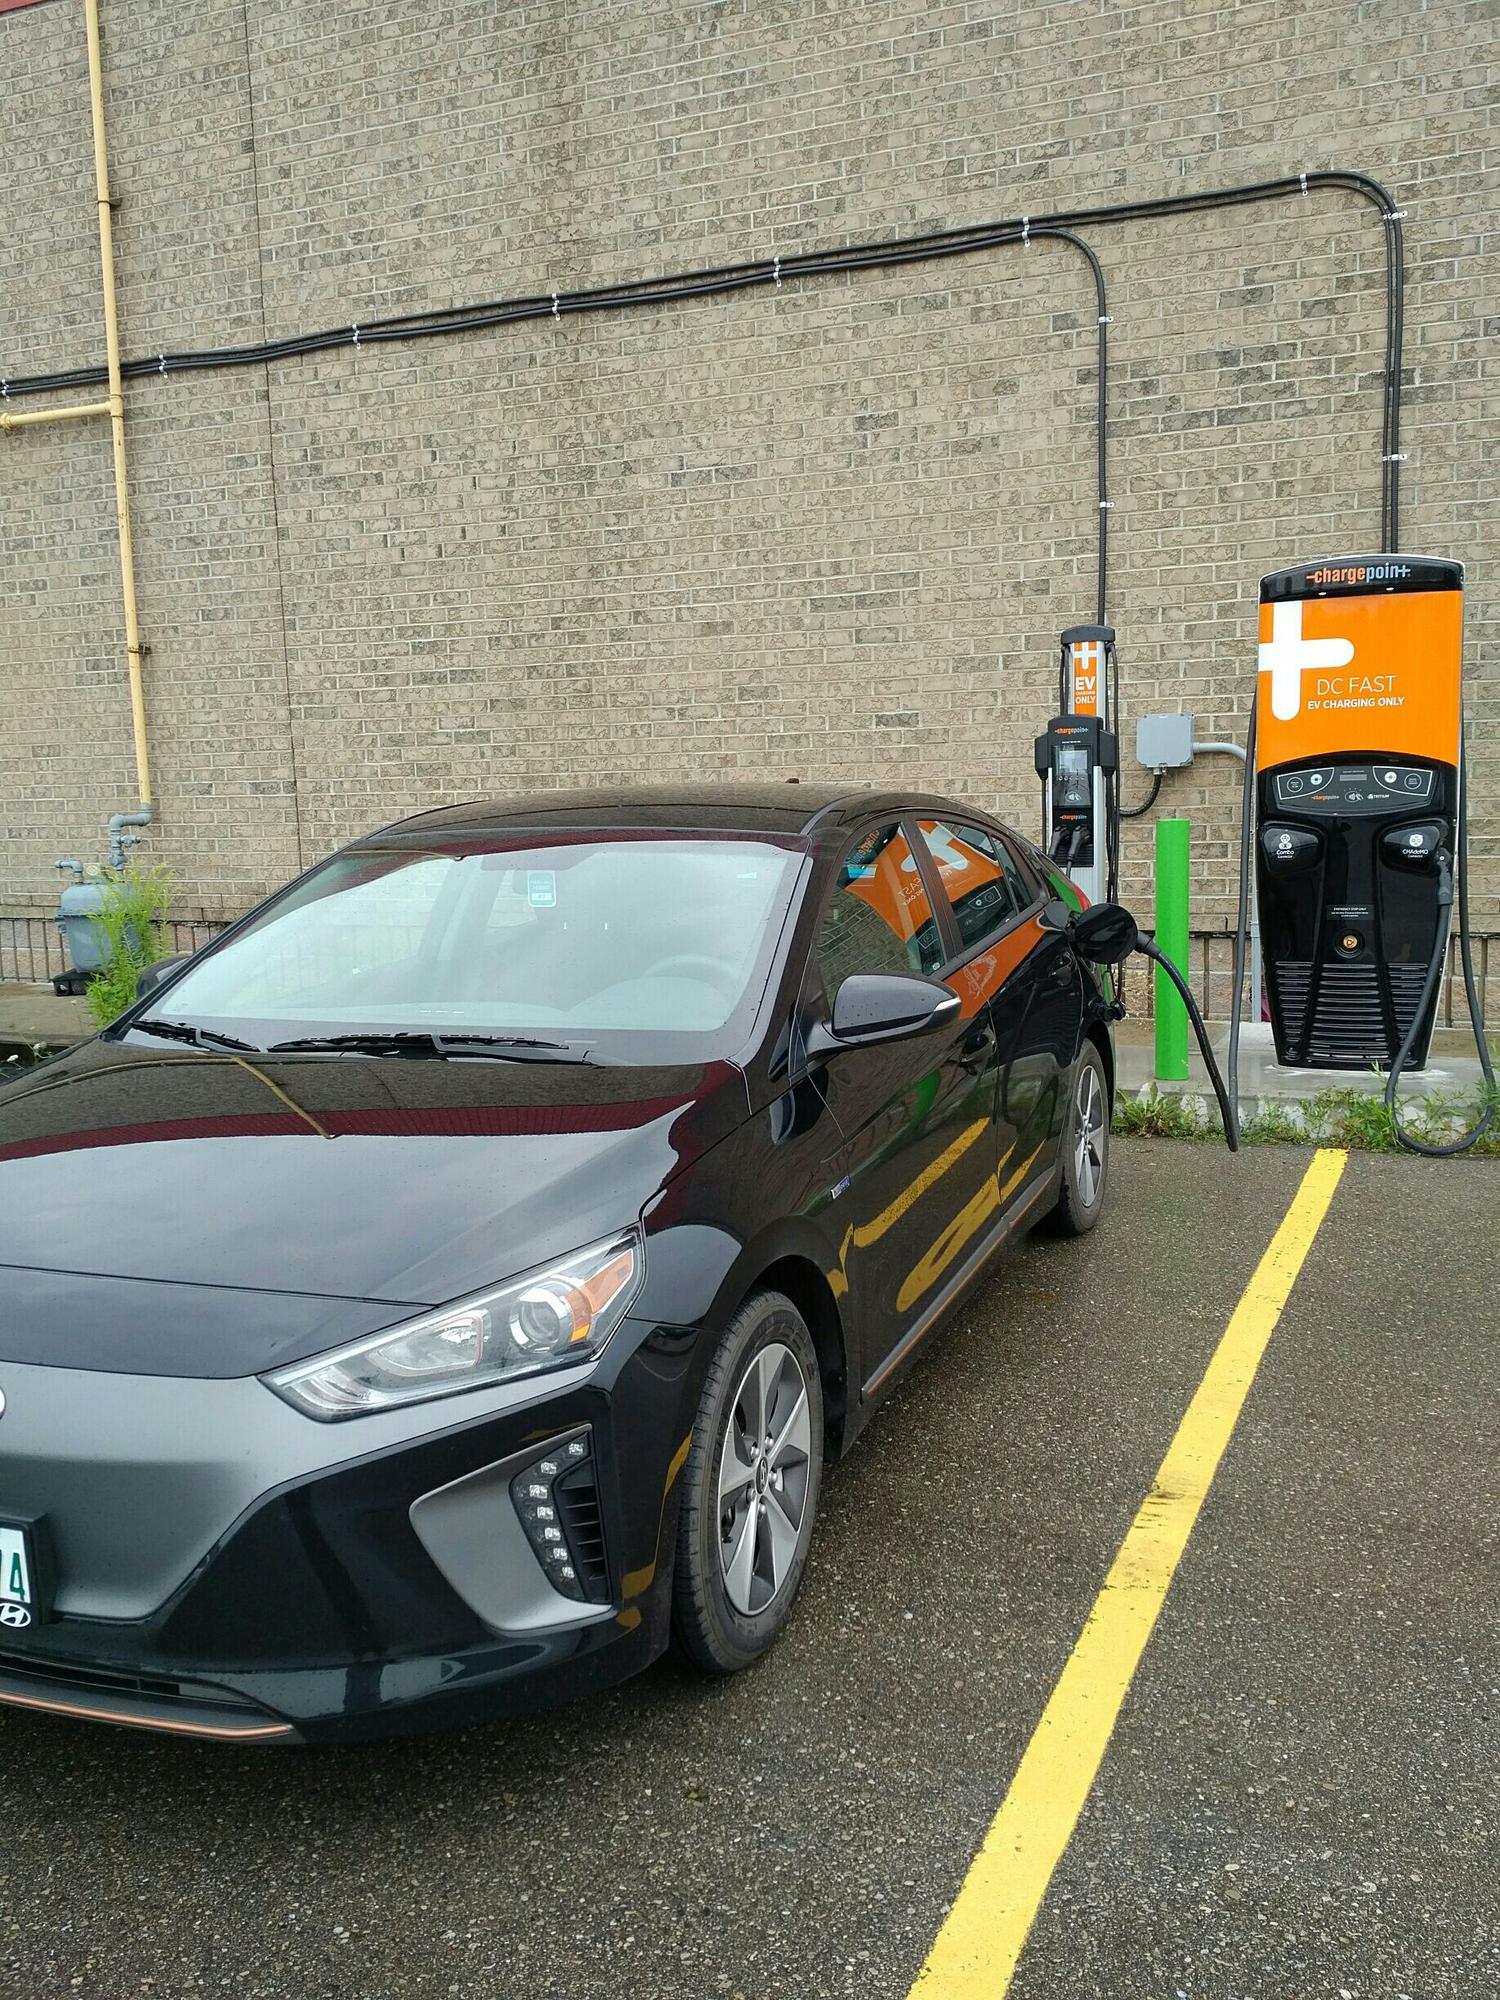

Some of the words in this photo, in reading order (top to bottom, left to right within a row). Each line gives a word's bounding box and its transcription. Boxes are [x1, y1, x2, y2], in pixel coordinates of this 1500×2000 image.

[1075, 676, 1096, 690] EV
[1317, 677, 1344, 695] DC
[1349, 675, 1396, 694] FAST
[1075, 695, 1096, 704] ONLY
[1307, 700, 1321, 710] EV
[1323, 698, 1376, 709] CHARGING
[1377, 696, 1405, 707] ONLY
